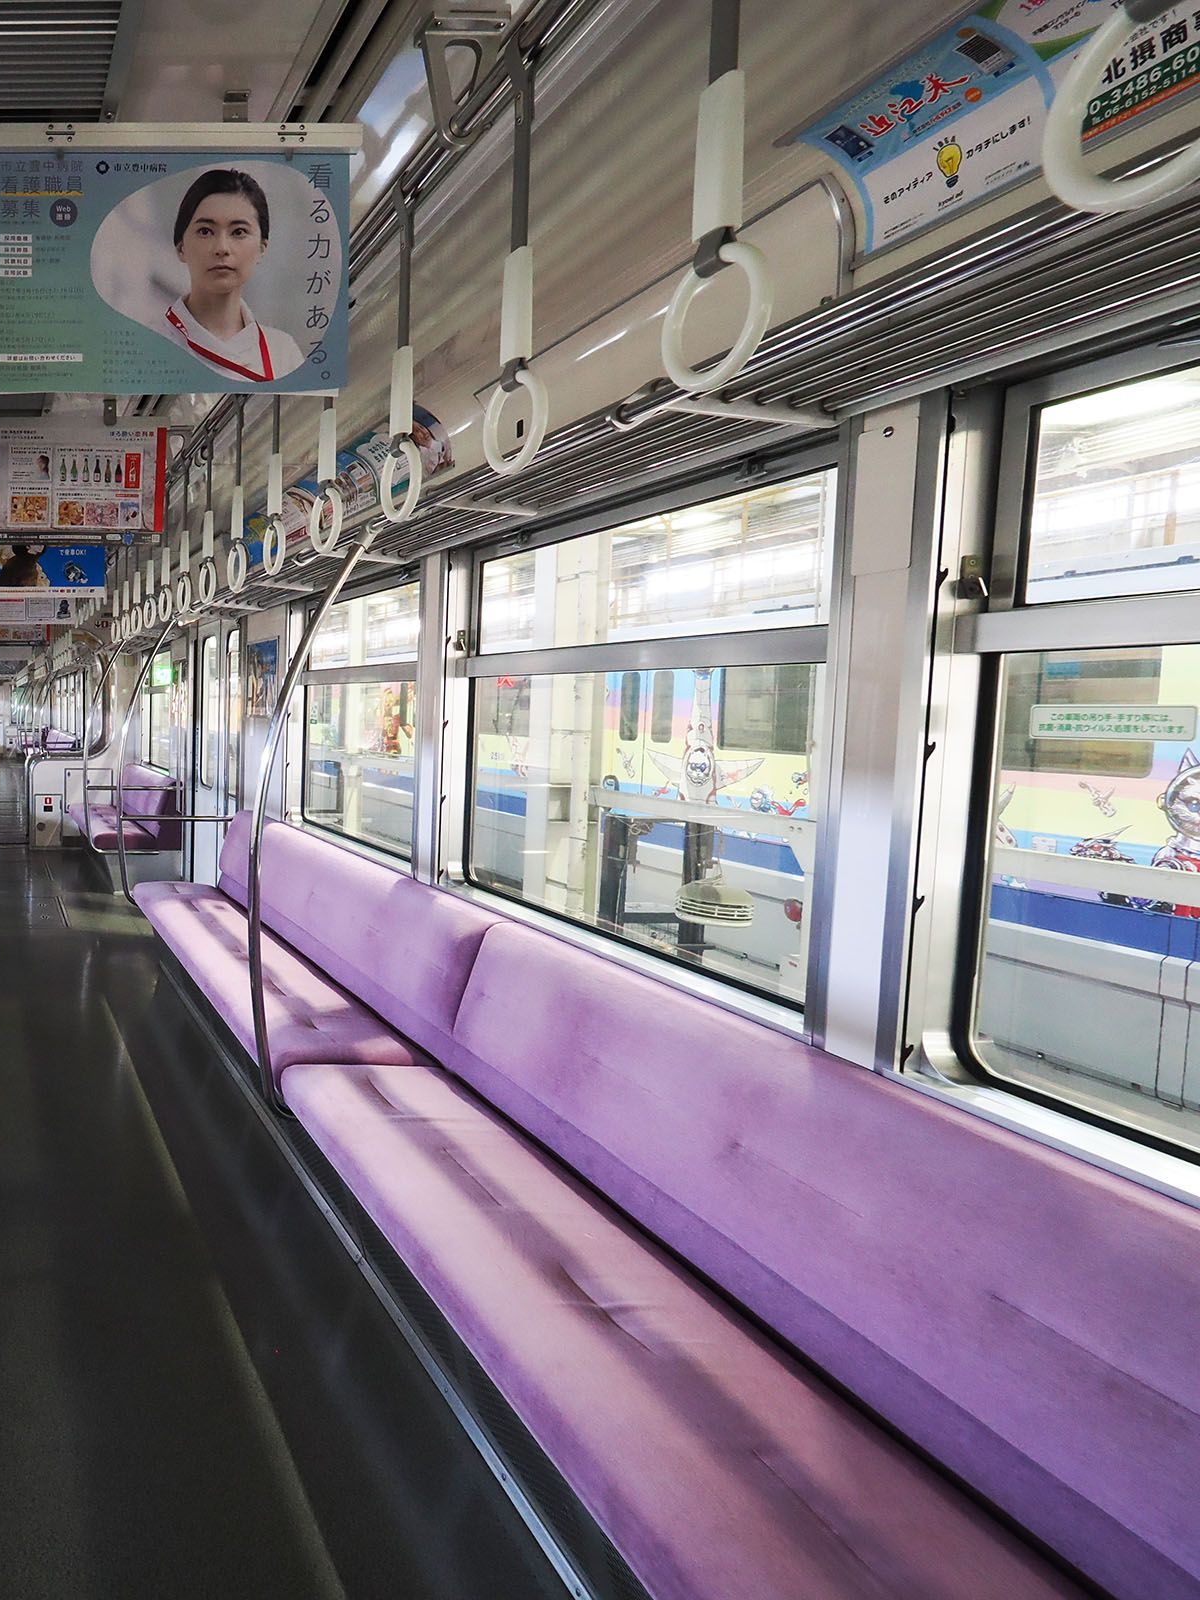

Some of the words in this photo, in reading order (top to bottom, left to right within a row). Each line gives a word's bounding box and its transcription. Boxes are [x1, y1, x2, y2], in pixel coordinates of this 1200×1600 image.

[933, 135, 956, 152] IDEA
[966, 115, 1032, 160] カタチにします!
[0, 159, 84, 173] 市立豊中病院
[113, 162, 168, 173] 市立豊中病院
[0, 175, 84, 195] 看護職員
[0, 199, 42, 219] 募集
[56, 204, 72, 213] Web
[306, 163, 333, 382] 看る力がある。
